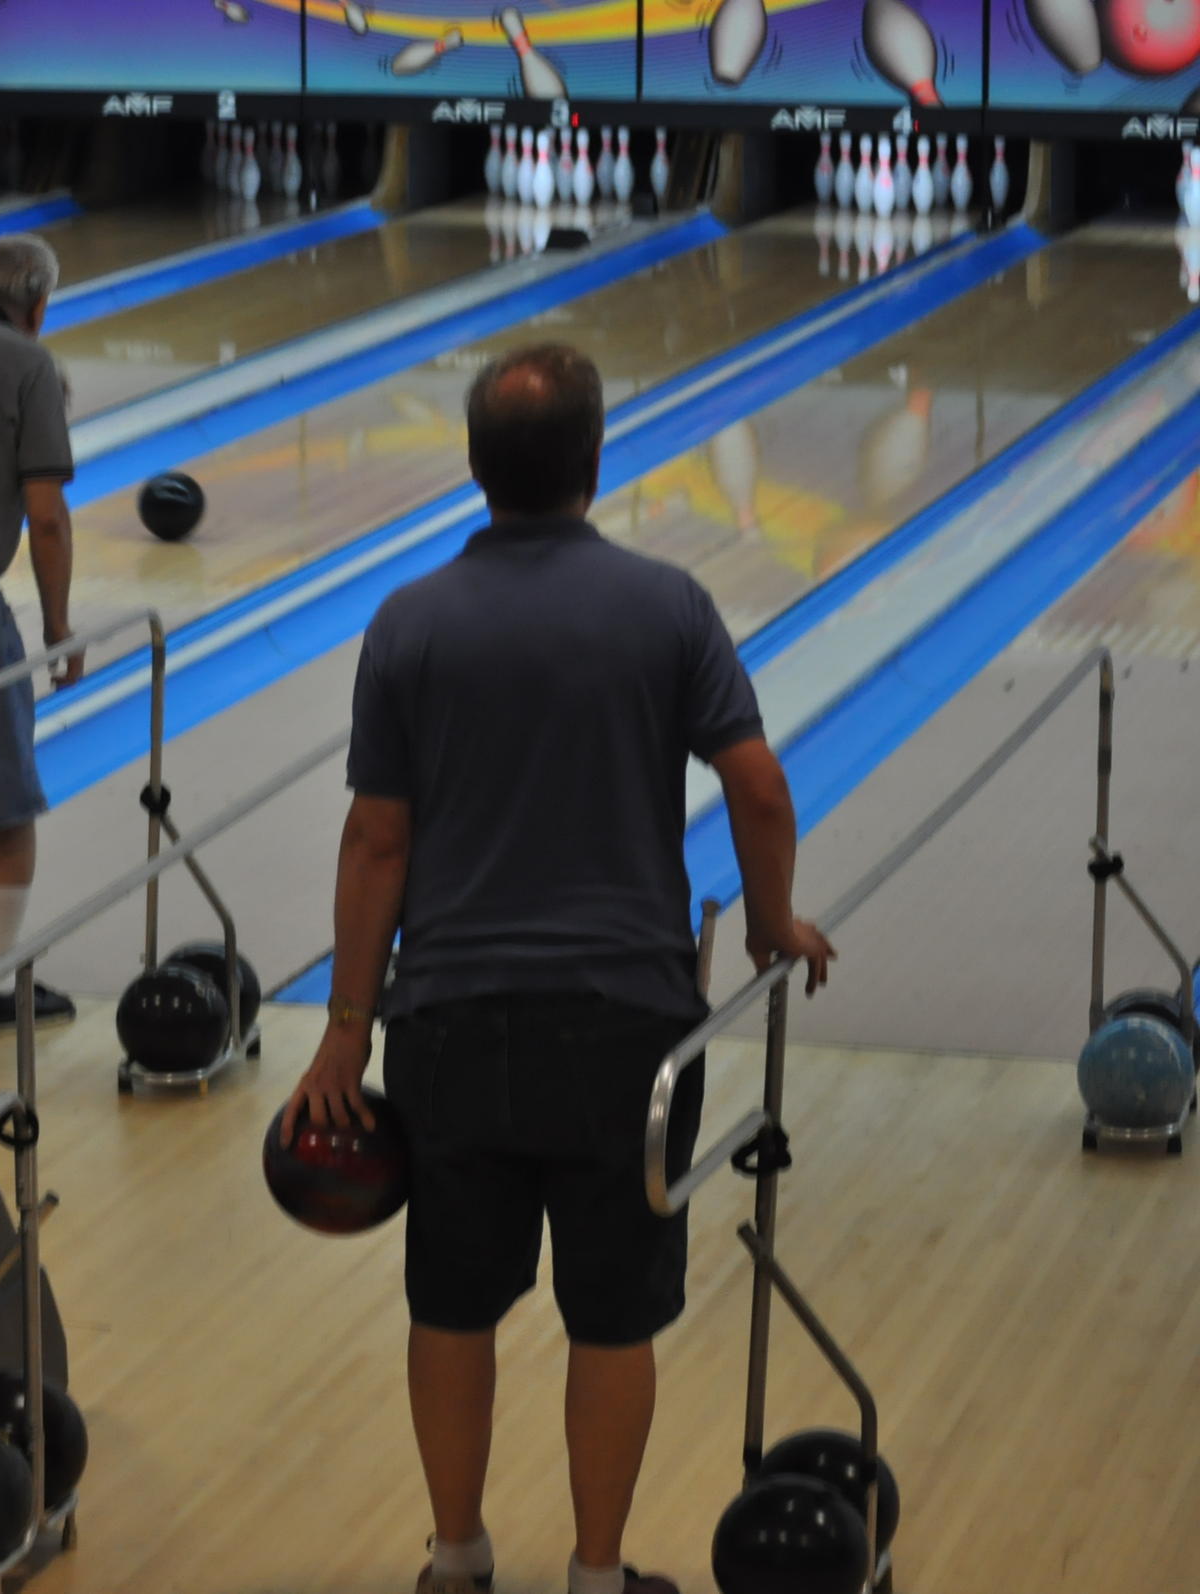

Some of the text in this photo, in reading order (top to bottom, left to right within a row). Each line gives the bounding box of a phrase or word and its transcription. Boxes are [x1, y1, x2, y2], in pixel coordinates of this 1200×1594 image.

[102, 91, 174, 117] AMF
[217, 89, 237, 120] 2
[432, 98, 505, 123] AMF
[551, 99, 570, 127] 3
[771, 105, 846, 131] AMF
[892, 104, 912, 138] 4
[1121, 112, 1199, 140] AMF
